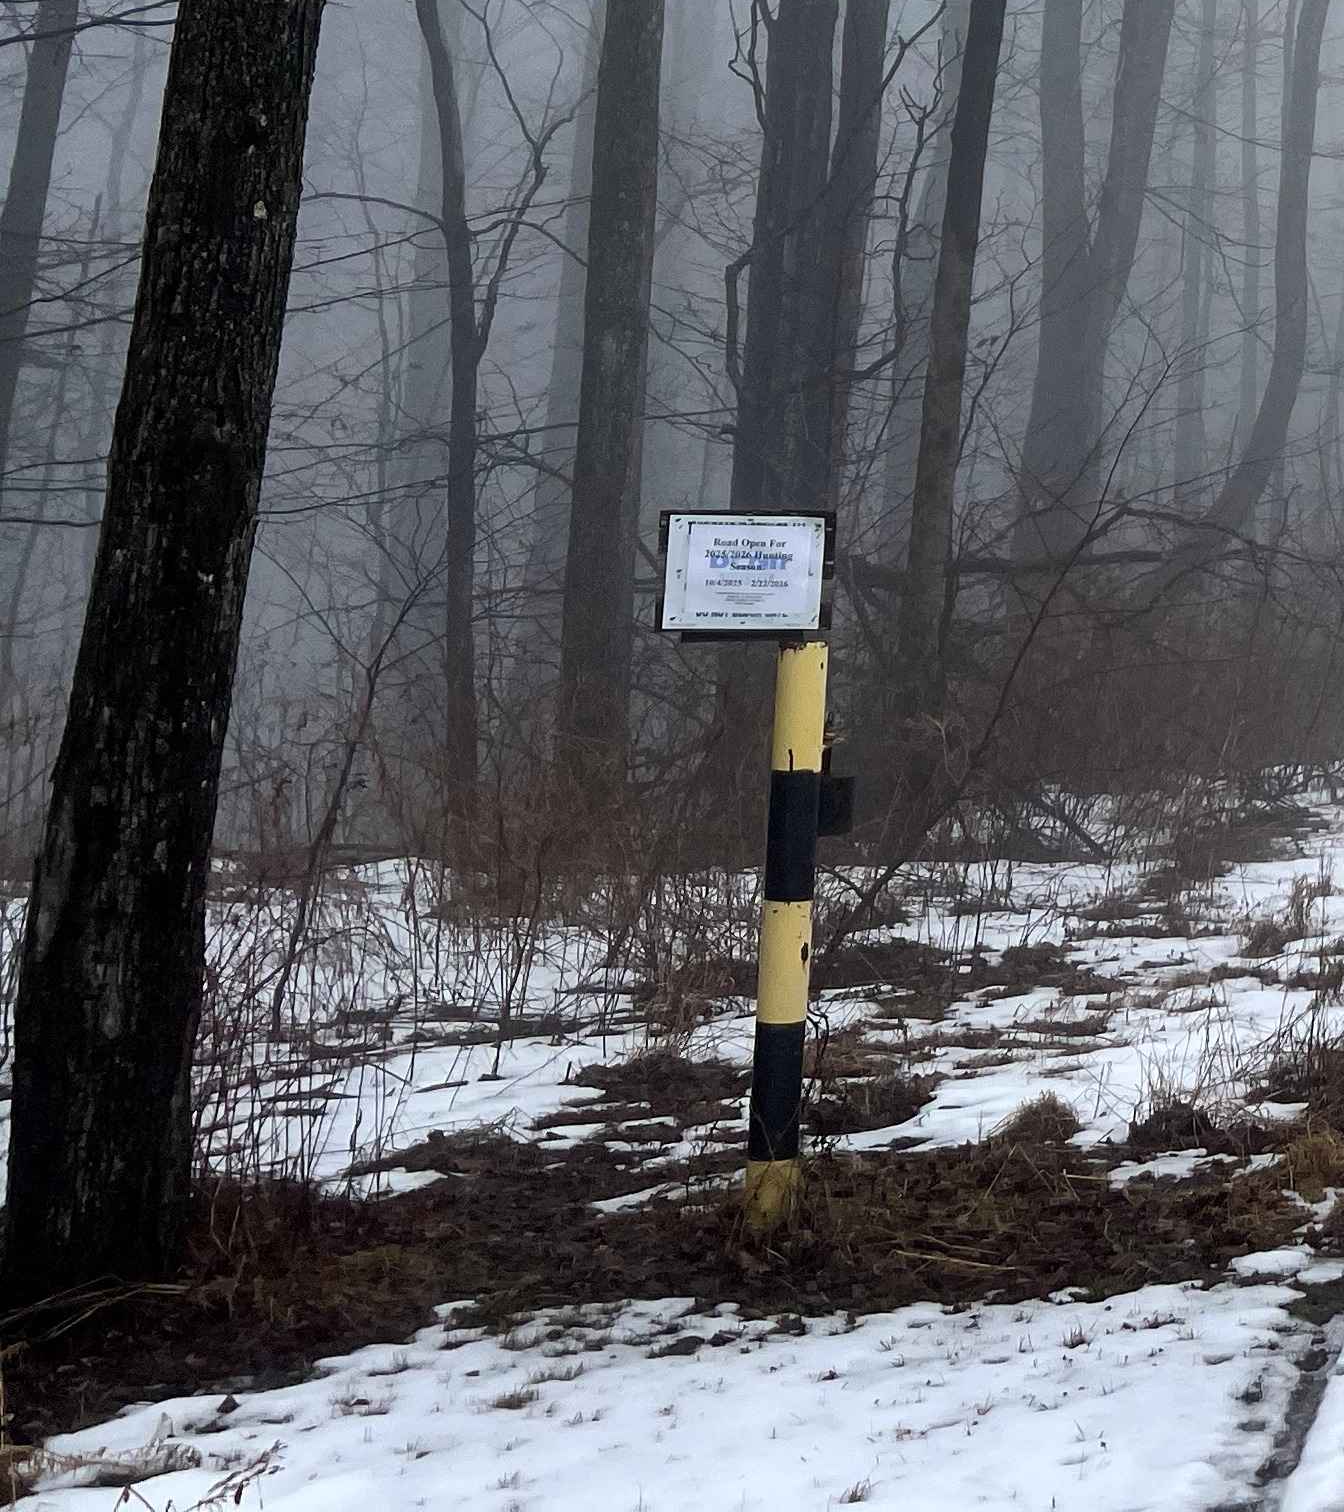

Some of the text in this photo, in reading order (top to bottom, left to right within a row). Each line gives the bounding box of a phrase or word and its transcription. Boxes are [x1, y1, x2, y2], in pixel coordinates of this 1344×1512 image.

[713, 538, 787, 549] Road Open For
